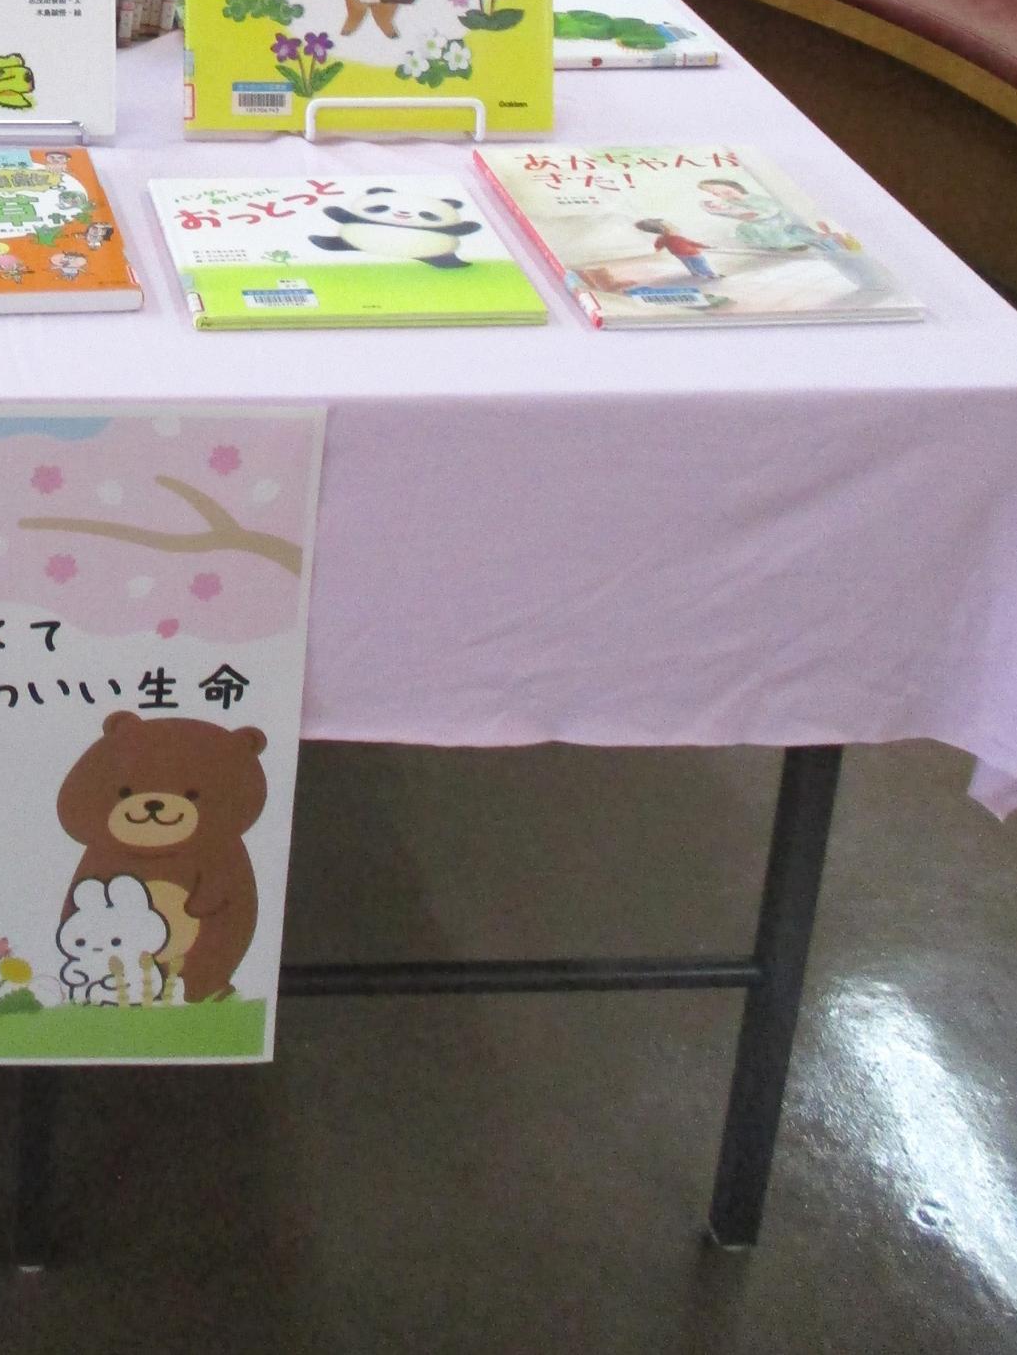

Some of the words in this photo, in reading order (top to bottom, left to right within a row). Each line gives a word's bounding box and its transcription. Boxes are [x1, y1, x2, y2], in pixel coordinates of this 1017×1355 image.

[515, 152, 739, 171] あかちゃんが
[174, 180, 345, 230] おっとっと
